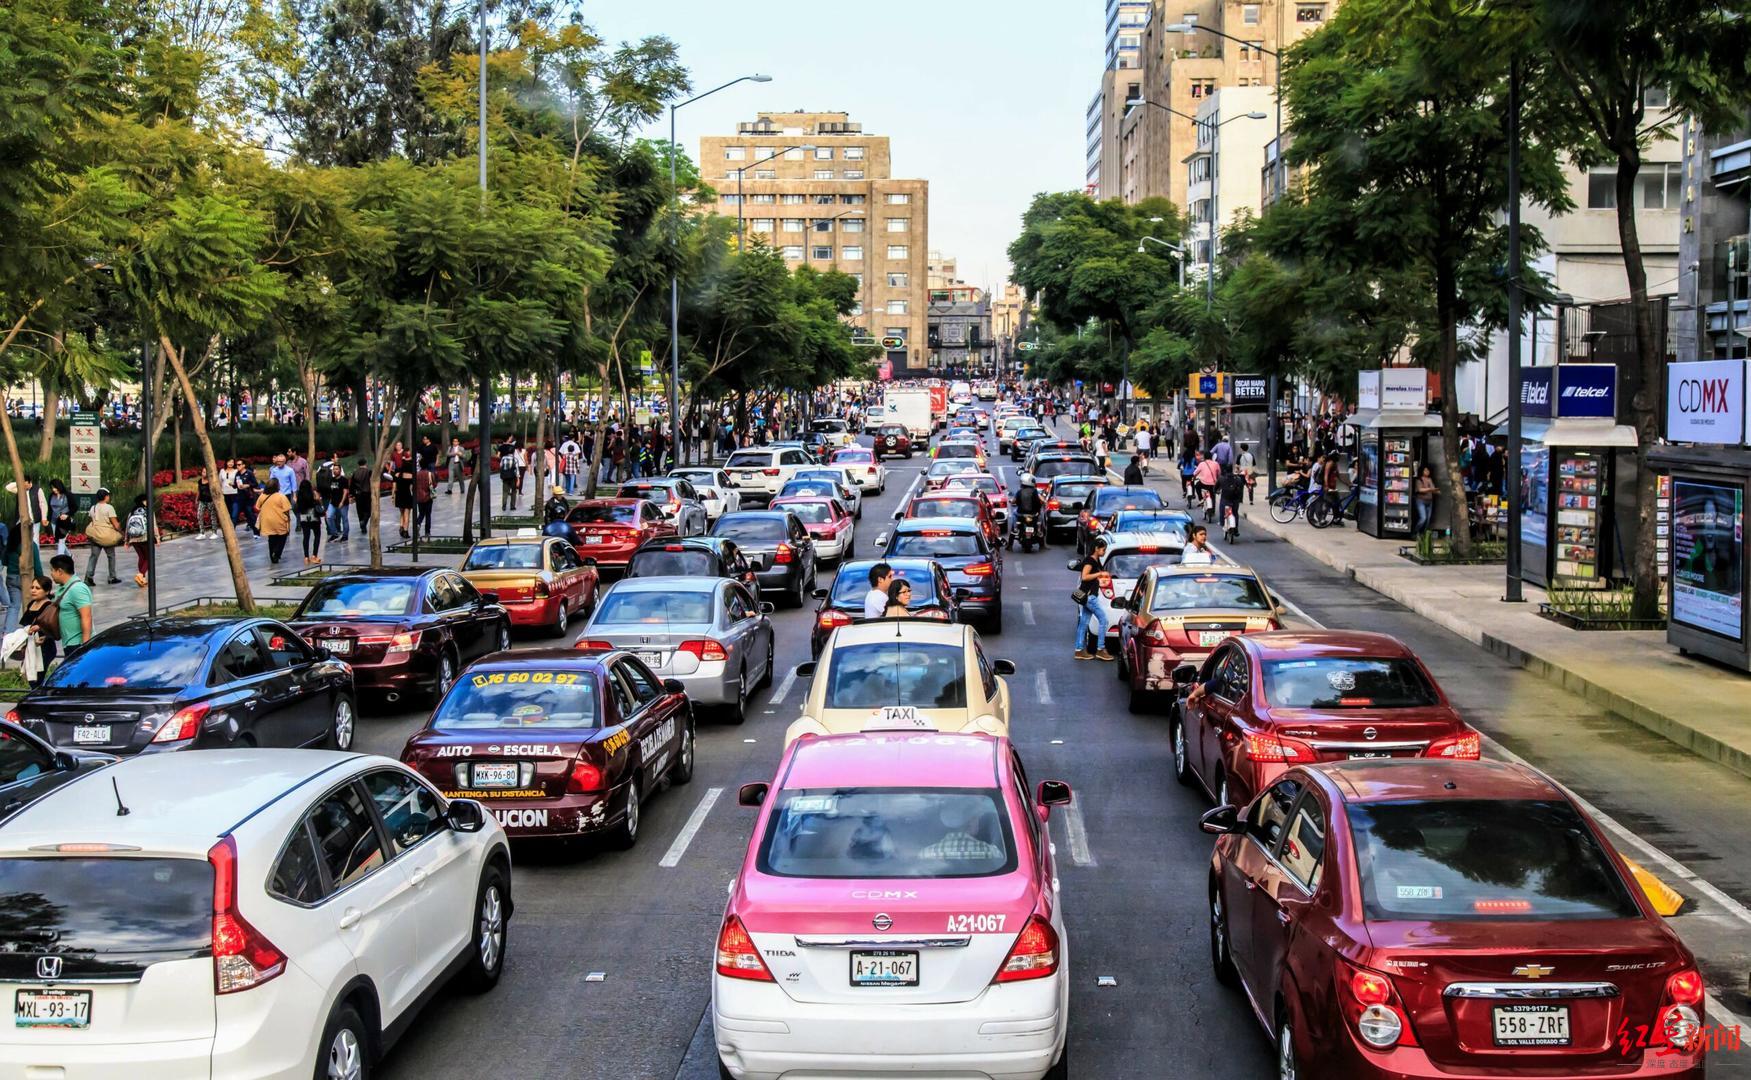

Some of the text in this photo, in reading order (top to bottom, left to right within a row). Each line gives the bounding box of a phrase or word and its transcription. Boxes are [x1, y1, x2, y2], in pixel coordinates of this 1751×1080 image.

[1235, 387, 1266, 396] BETETA
[1526, 381, 1549, 405] telcel
[1573, 386, 1609, 397] telcel
[1678, 378, 1729, 413] CDMX
[488, 672, 577, 685] 16 60 02 97
[883, 708, 915, 720] TAXI
[77, 729, 106, 739] F42-ALG
[437, 745, 562, 757] AUTO ESCUELA
[475, 769, 516, 780] MXK-96-80
[501, 790, 546, 798] DISTANCIA
[496, 809, 548, 828] UCION
[852, 890, 918, 899] CDMX
[764, 949, 796, 957] TIIDA
[856, 960, 912, 976] A-21-067
[17, 1001, 88, 1018] MXL-93-17
[1499, 1016, 1565, 1034] 558-ZRF
